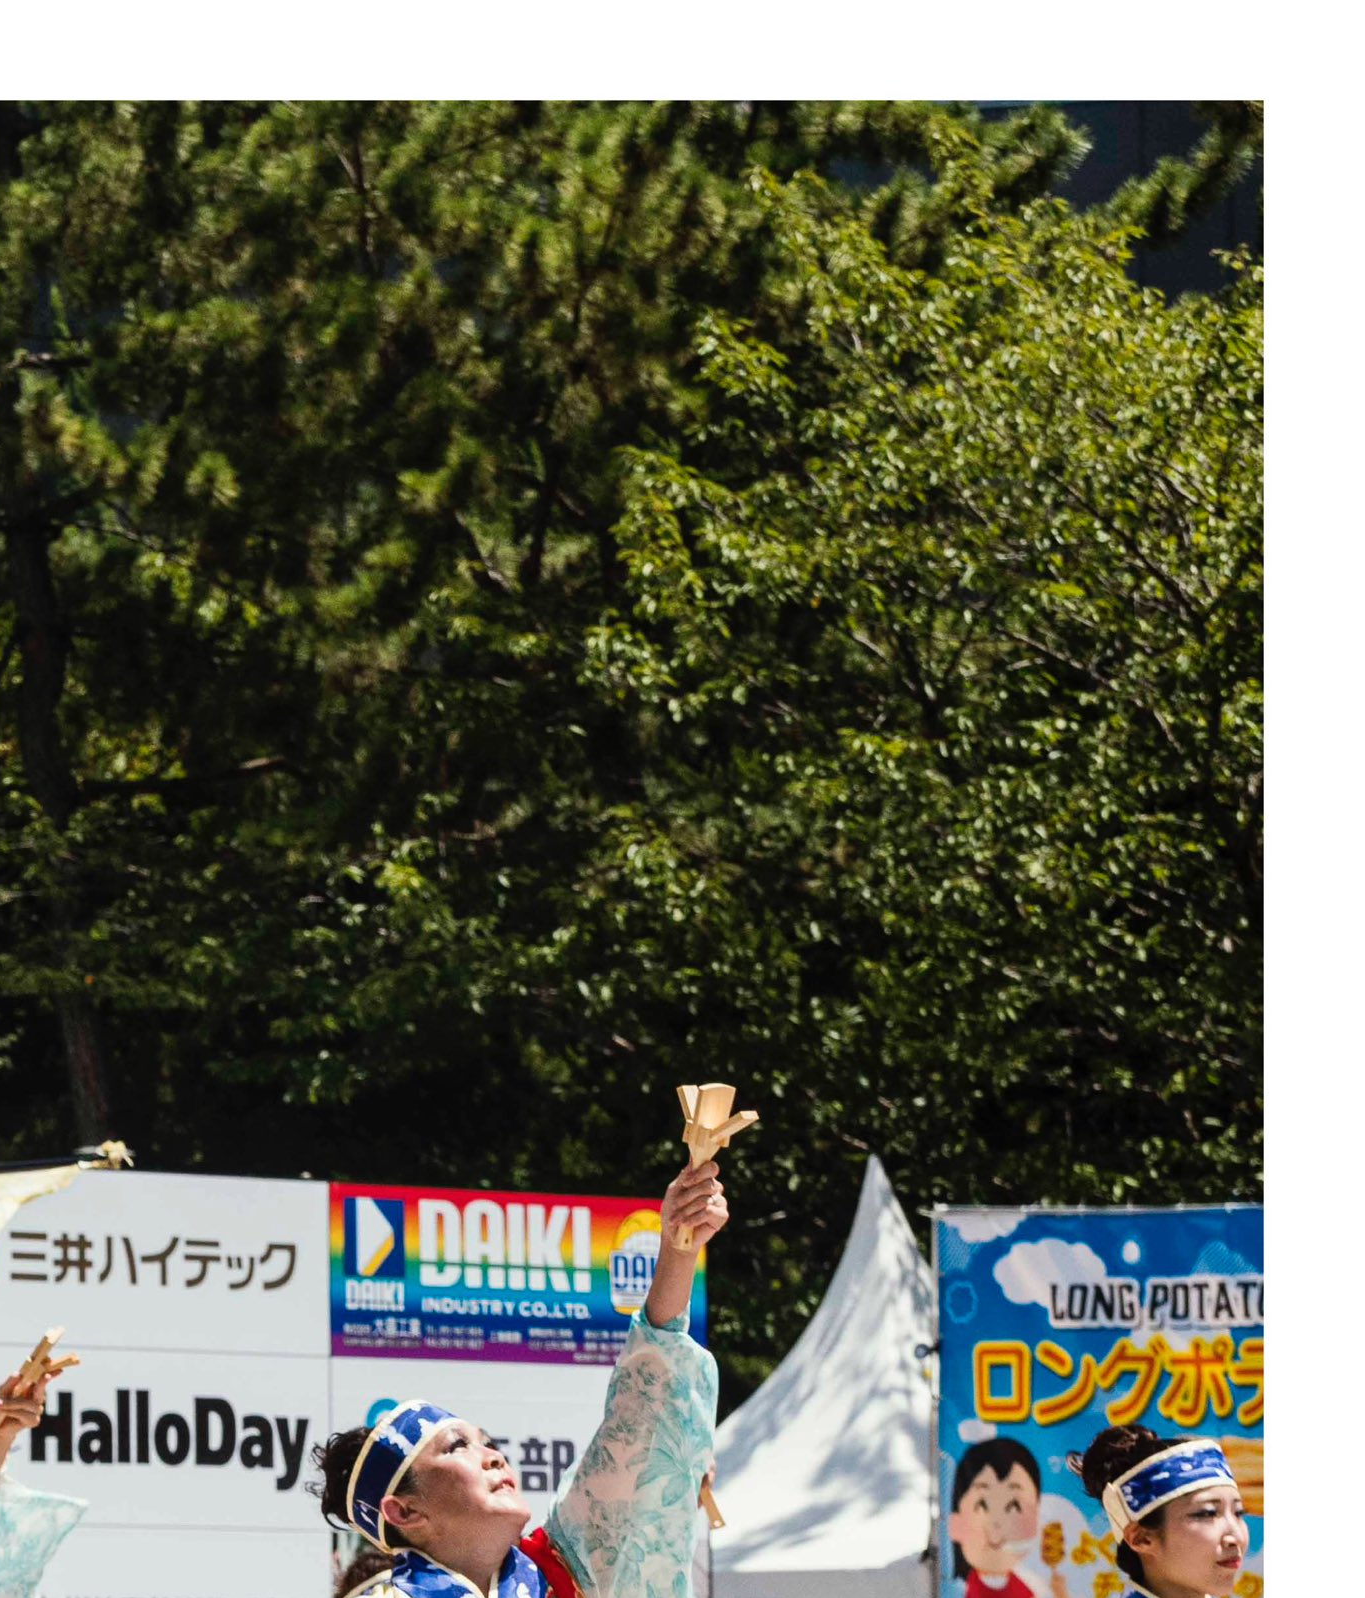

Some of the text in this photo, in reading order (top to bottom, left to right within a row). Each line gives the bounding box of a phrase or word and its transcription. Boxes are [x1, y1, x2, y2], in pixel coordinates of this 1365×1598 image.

[9, 1231, 297, 1291] 三井ハイテック
[418, 1198, 592, 1292] DAIKI
[345, 1279, 405, 1312] DAIKI
[421, 1297, 516, 1316] INDUSTRY
[1051, 1283, 1136, 1322] LONG
[31, 1388, 310, 1491] HalloDay
